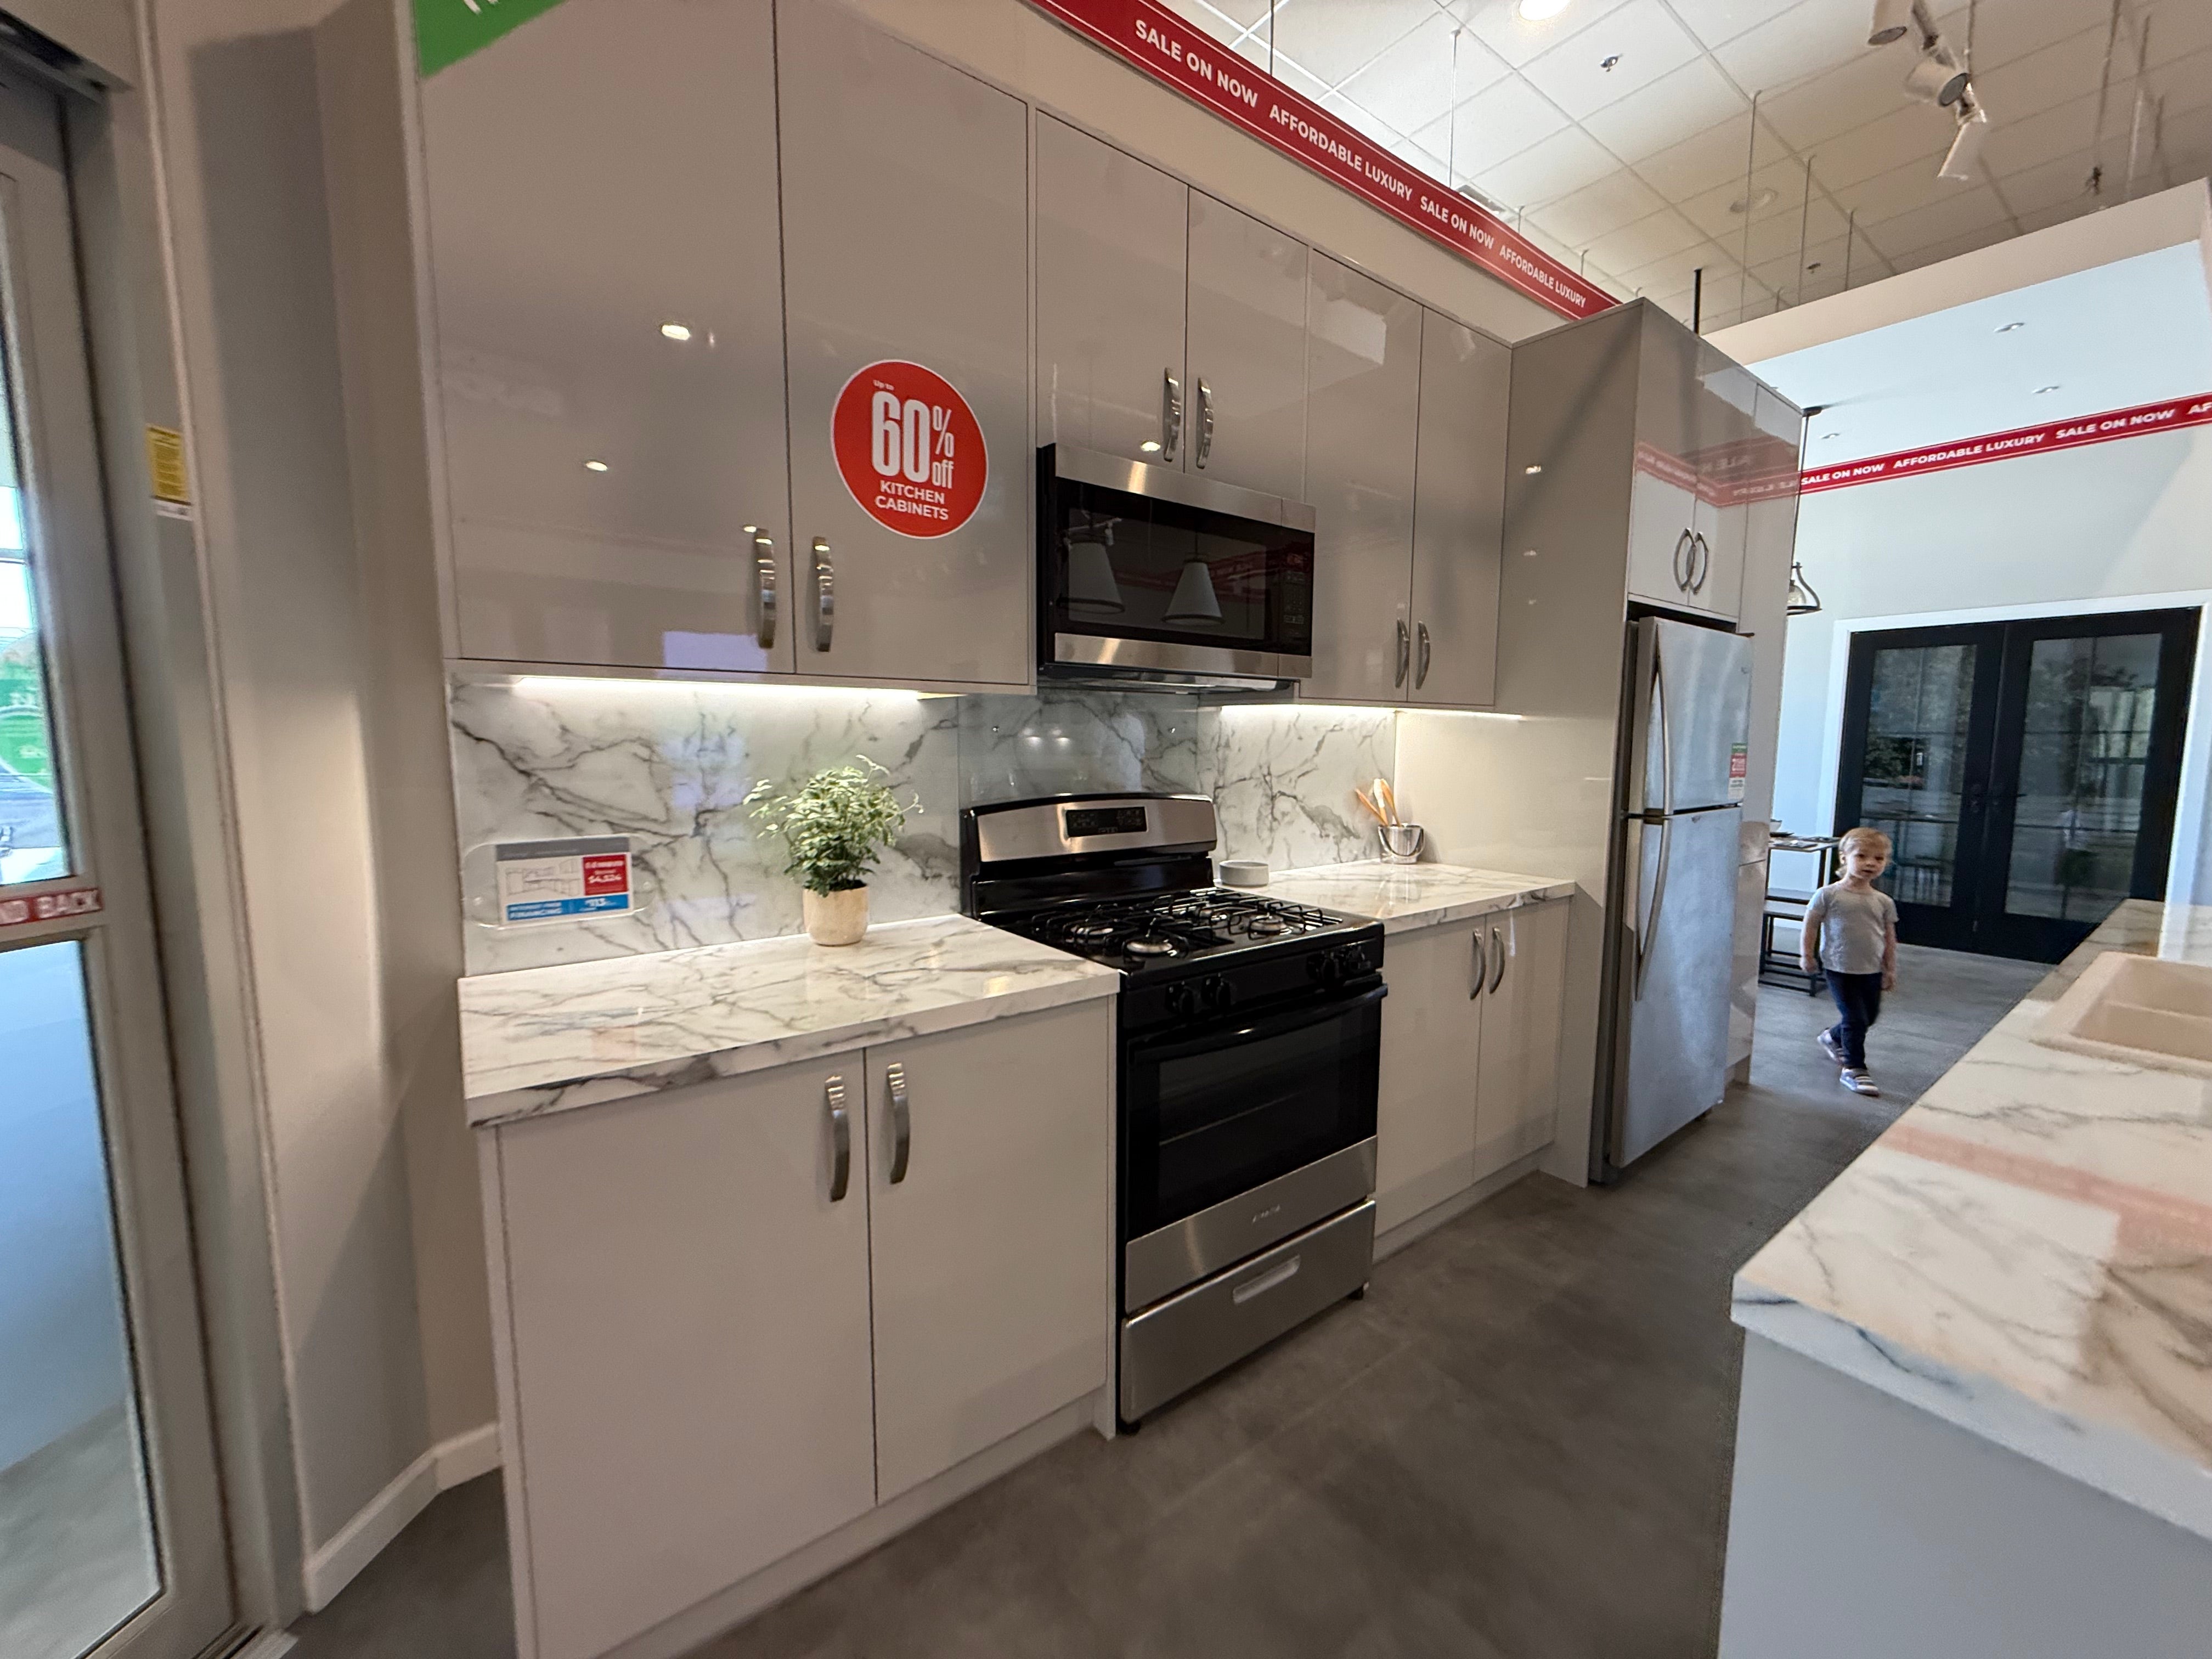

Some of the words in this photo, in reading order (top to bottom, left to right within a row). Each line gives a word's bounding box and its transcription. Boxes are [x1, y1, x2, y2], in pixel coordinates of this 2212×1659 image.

[1136, 20, 1182, 63] SALE
[1187, 52, 1212, 81] ON
[1217, 70, 1258, 108] NOW
[1269, 104, 1362, 172] AFFORDABLE
[1365, 161, 1413, 201] LUXURY
[1420, 195, 1448, 224] SALE
[1451, 214, 1467, 234] ON
[1469, 223, 1494, 249] NOW
[1499, 245, 1554, 290] AFFORDABLE
[1555, 280, 1587, 308] LUXURY
[872, 391, 955, 483] 60%
[932, 459, 955, 489] off
[1801, 472, 1831, 486] SALE
[1832, 470, 1850, 480] ON
[1853, 463, 1886, 477] NOW
[1893, 444, 1983, 469] AFFORDABLE
[1985, 433, 2046, 452] LUXURY
[2055, 424, 2097, 439] SALE
[2100, 417, 2126, 431] ON
[2130, 408, 2176, 425] NOW
[874, 496, 949, 521] CABINETS
[880, 480, 945, 505] KITCHEN
